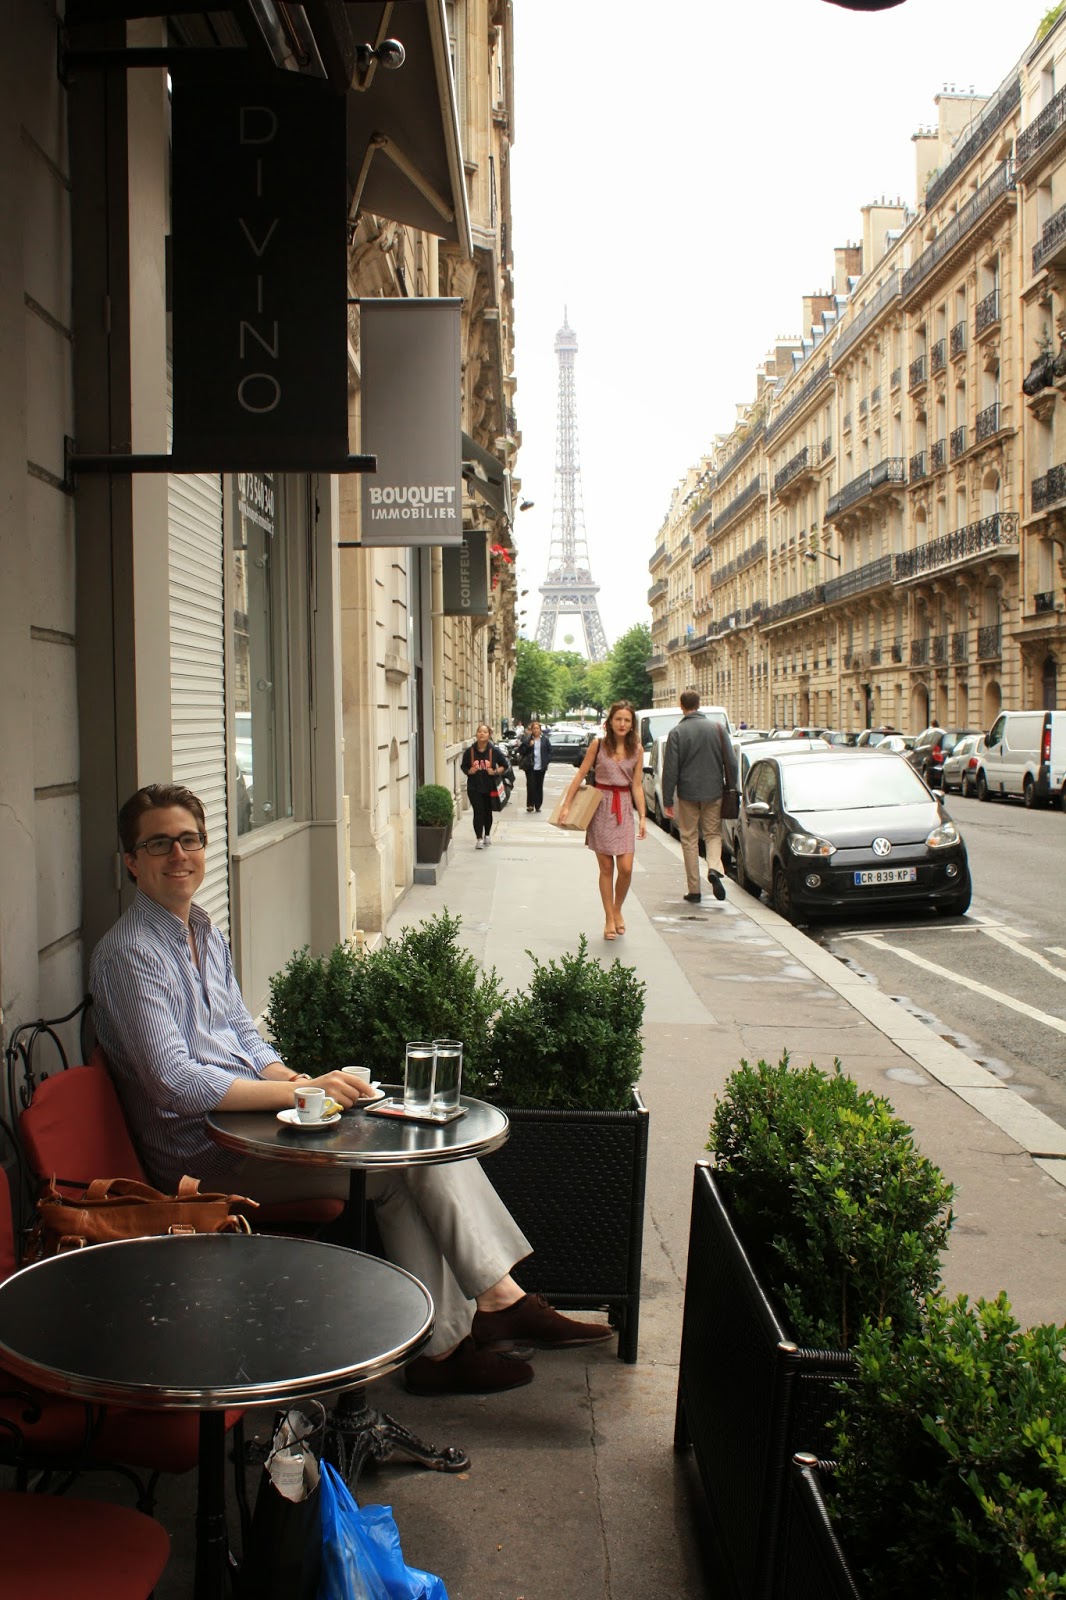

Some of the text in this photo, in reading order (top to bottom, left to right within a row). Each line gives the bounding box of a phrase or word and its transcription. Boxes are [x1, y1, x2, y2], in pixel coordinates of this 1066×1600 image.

[238, 106, 282, 414] DIVINO
[369, 486, 456, 507] BOUQUET
[371, 507, 457, 520] IMMOBILIER
